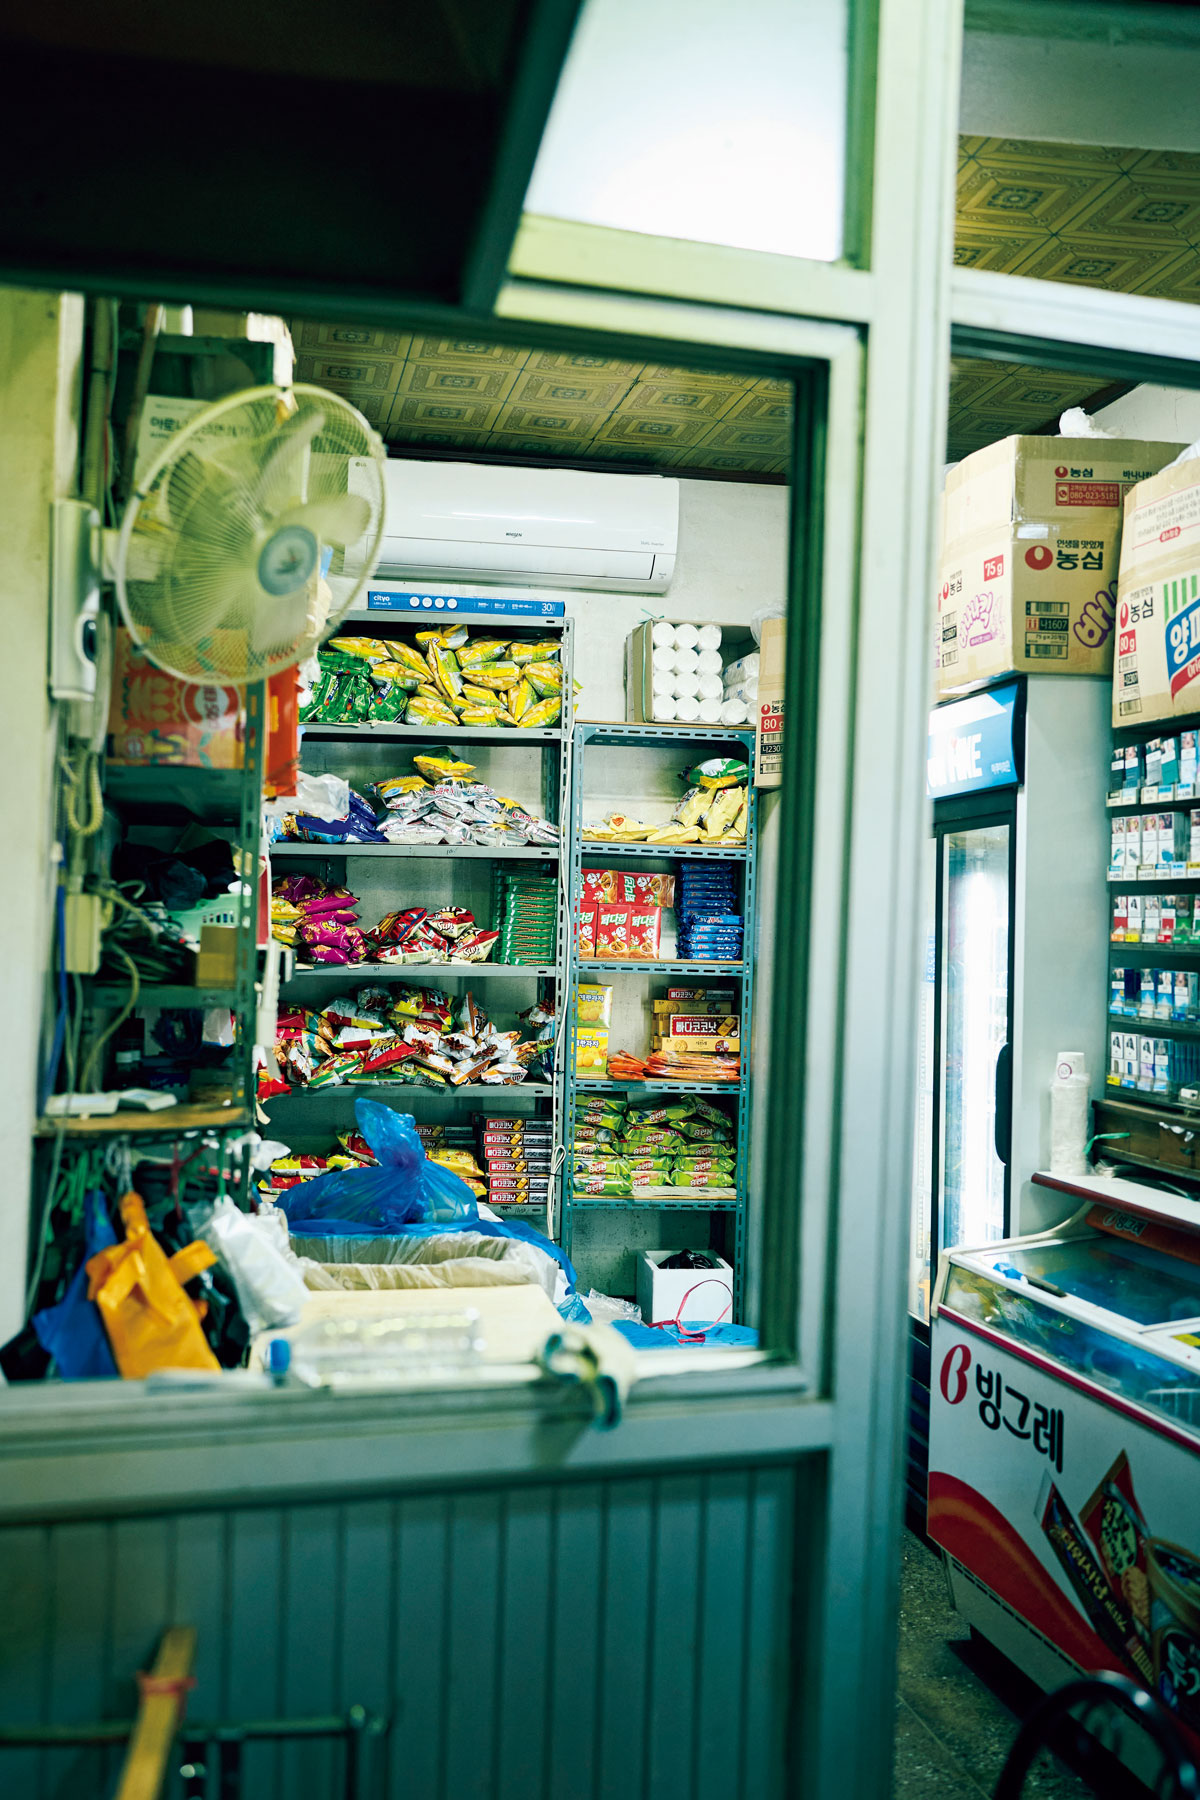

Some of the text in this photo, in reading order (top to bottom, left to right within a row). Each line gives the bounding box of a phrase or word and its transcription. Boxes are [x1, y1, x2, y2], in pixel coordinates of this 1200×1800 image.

[1070, 467, 1093, 478] 농심
[1070, 491, 1118, 500] 080-023-5181
[1056, 549, 1104, 571] 농심
[985, 561, 997, 577] 75
[1130, 596, 1154, 624] 농심
[763, 718, 776, 730] 80
[601, 913, 628, 926] 닭다리
[676, 1021, 717, 1034] 빠다코코낫
[976, 1363, 1064, 1474] 빙그레
